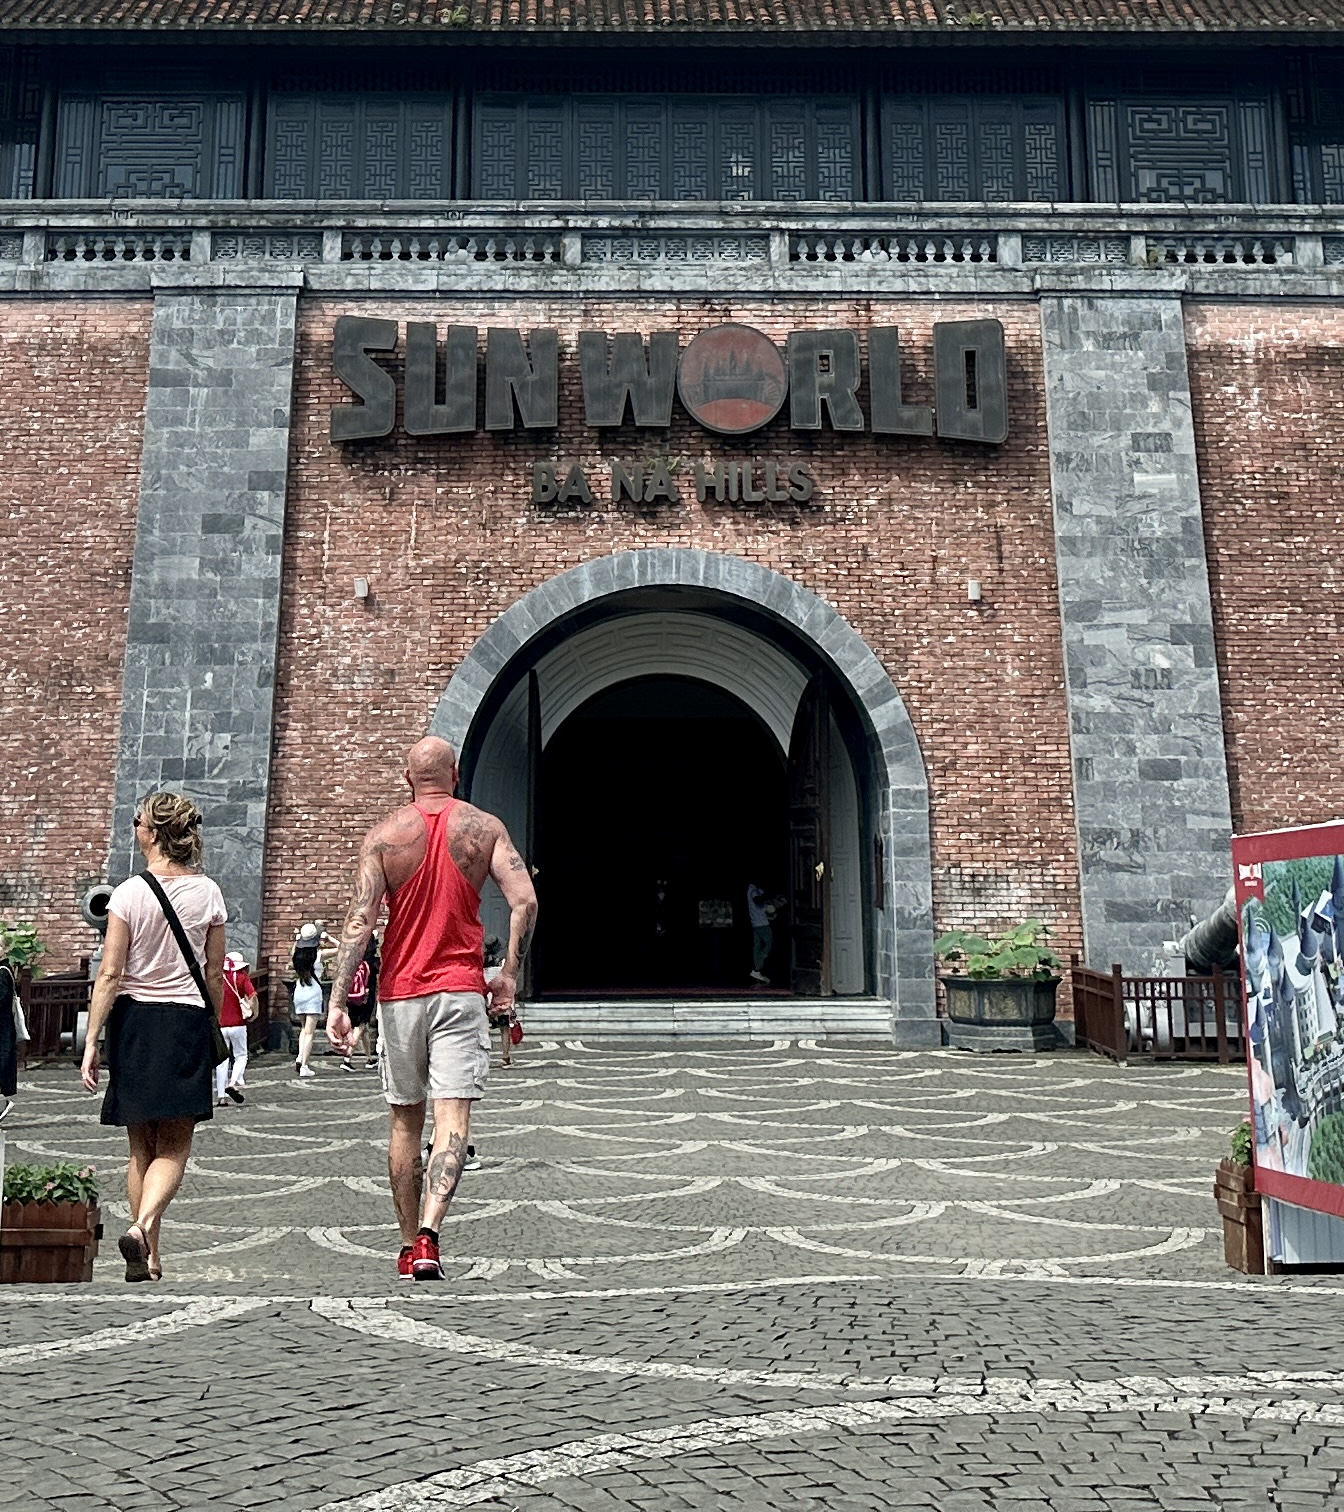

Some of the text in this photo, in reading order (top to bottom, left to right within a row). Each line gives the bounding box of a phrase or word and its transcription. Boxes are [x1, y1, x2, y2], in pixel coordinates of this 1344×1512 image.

[330, 315, 1009, 444] SUN WORLD
[532, 461, 815, 503] BA NA HILLS
